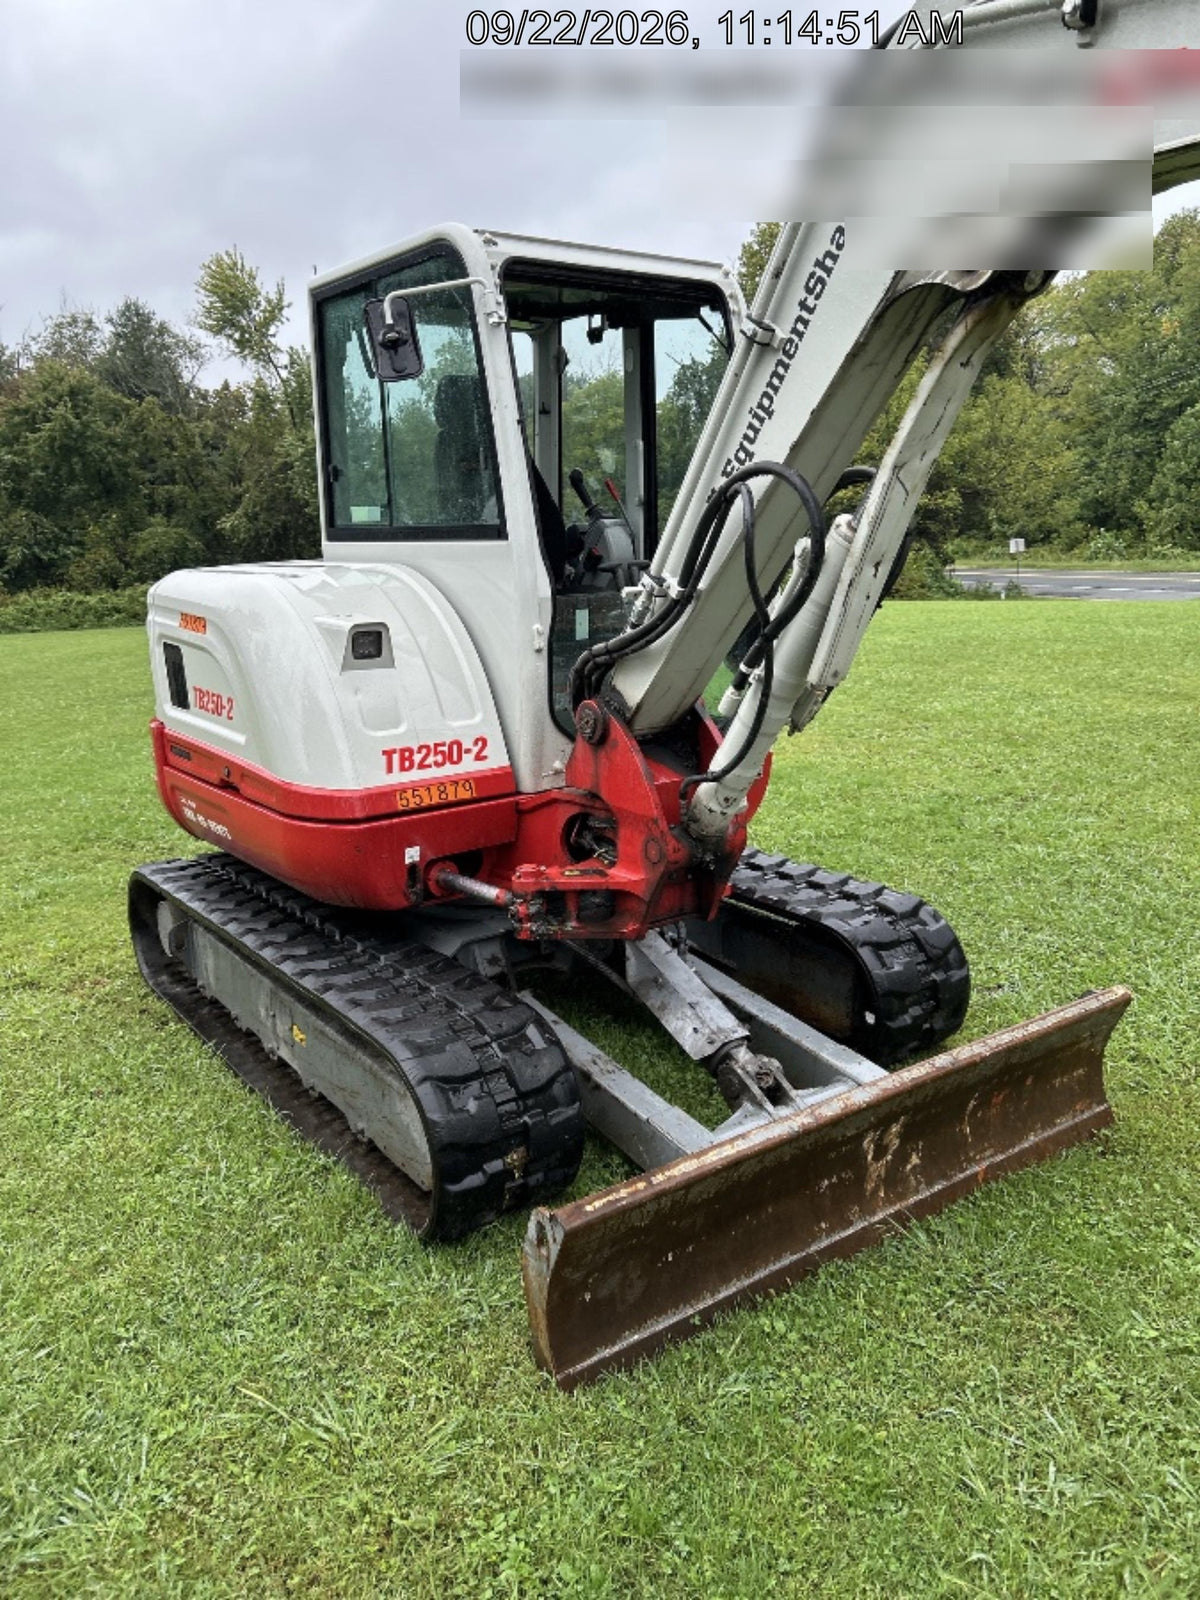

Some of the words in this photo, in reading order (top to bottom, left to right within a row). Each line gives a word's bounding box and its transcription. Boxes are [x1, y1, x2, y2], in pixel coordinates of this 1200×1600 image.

[193, 686, 234, 721] TB250-2
[382, 735, 488, 775] TB250-2
[398, 779, 474, 808] 551879
